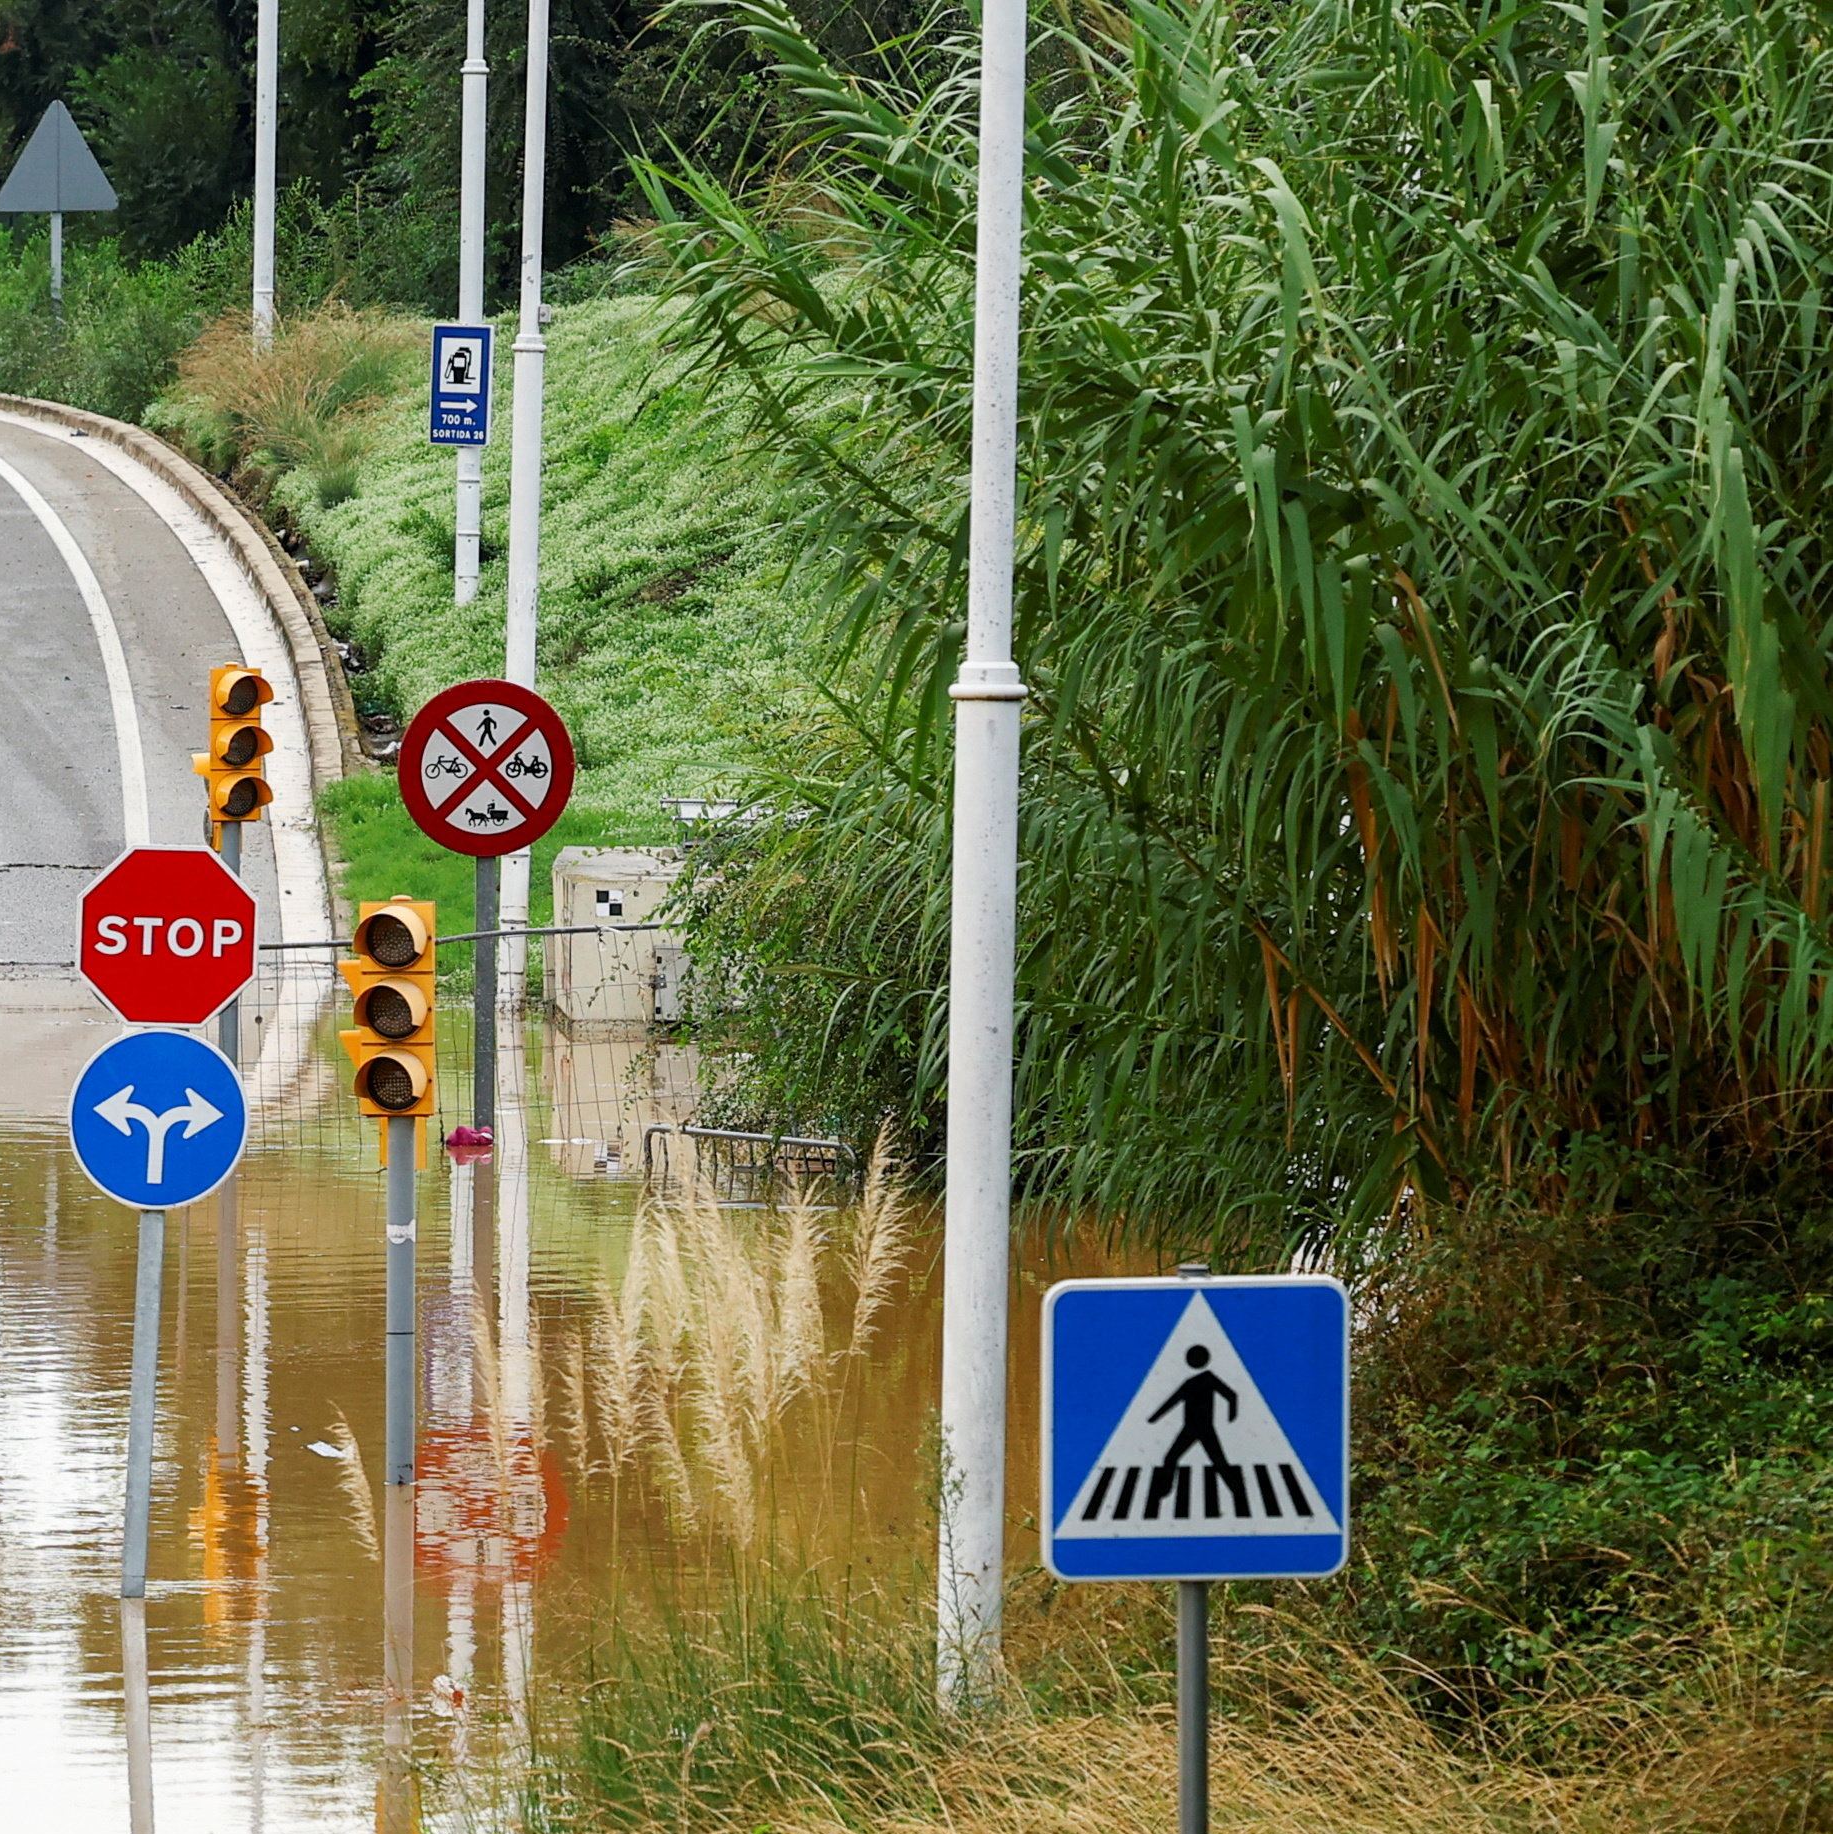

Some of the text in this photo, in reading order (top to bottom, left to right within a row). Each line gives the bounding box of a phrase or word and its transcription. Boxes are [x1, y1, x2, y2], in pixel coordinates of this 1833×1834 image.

[441, 414, 461, 425] 700
[433, 429, 471, 439] SORTIDA
[94, 915, 243, 957] STOP
